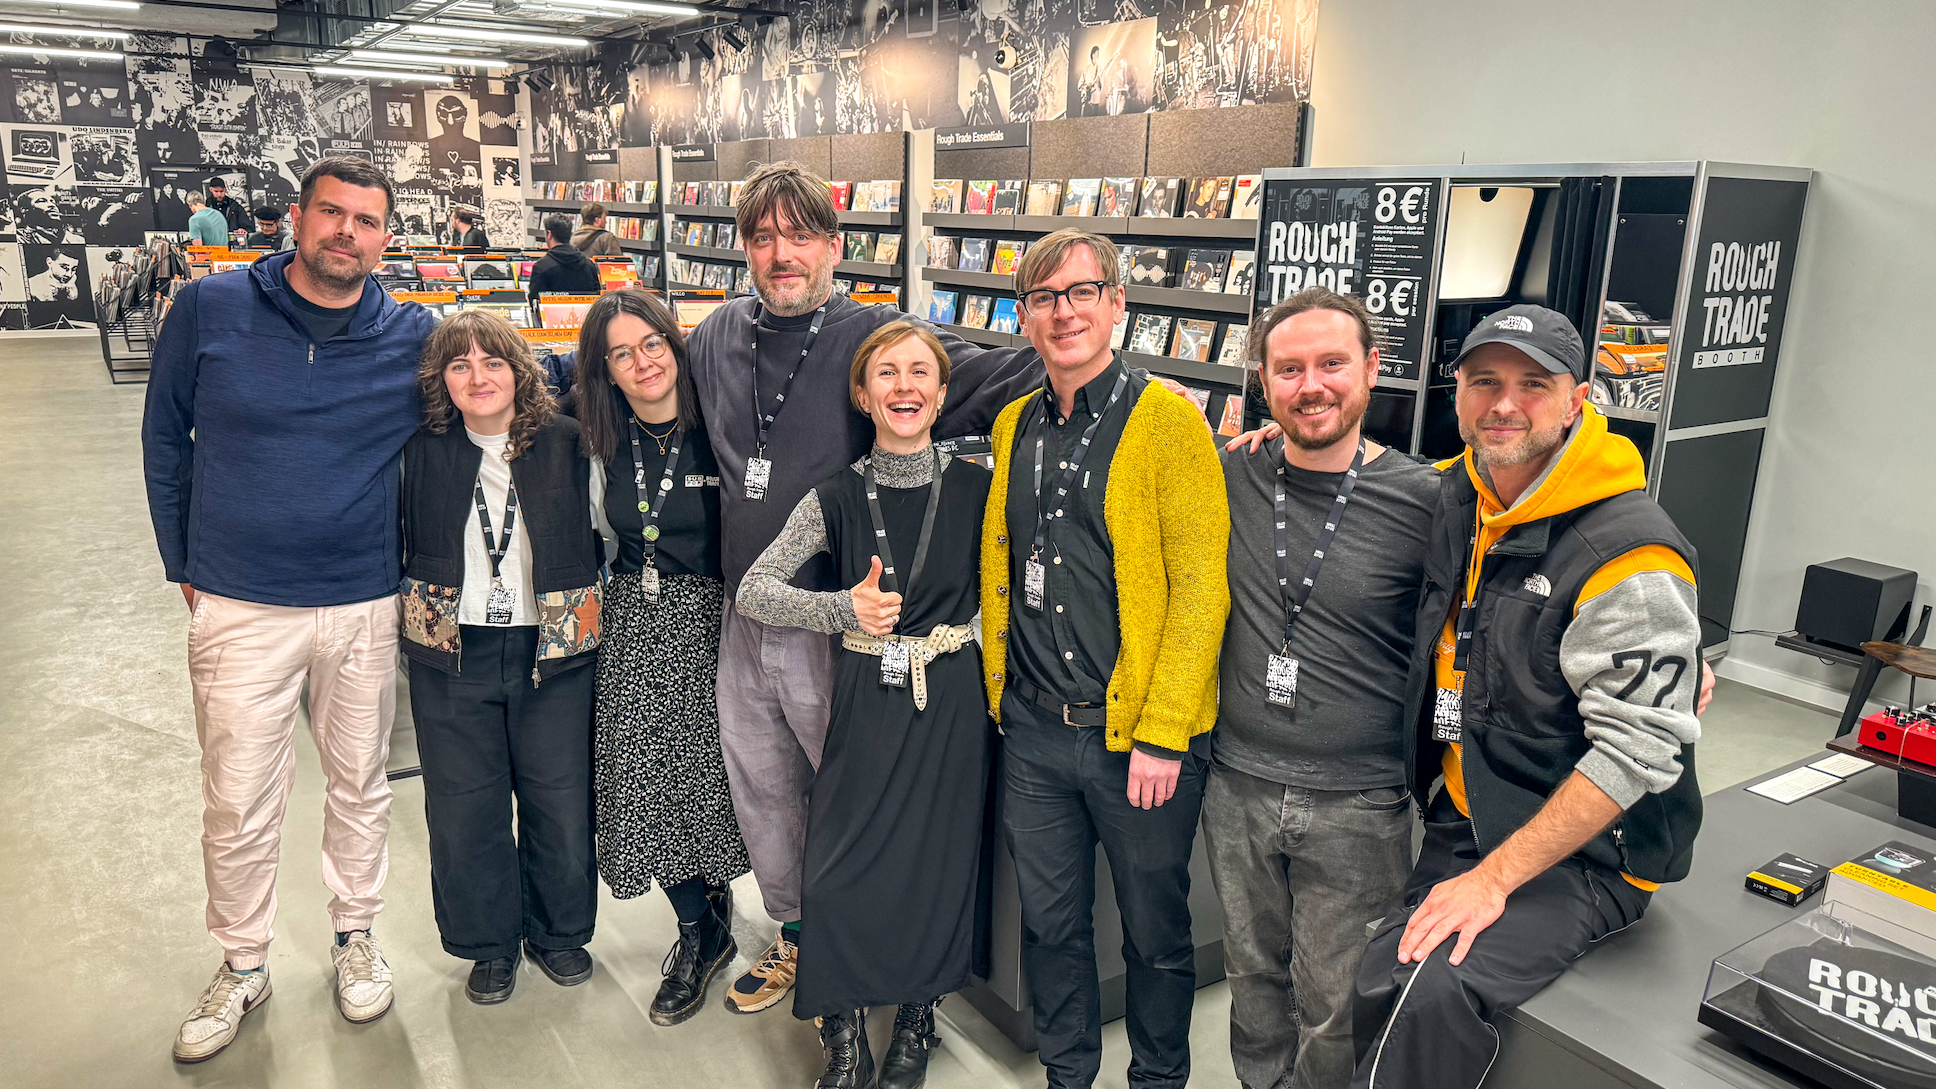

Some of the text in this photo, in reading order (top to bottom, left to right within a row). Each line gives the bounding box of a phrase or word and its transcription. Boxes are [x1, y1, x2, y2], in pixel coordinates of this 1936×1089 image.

[937, 130, 1004, 146] Rough Trade Essentials
[1268, 221, 1357, 265] ROUGH
[1705, 240, 1781, 293] ROUGH
[1412, 281, 1420, 306] session
[1702, 295, 1773, 348] TRADE
[1697, 350, 1761, 365] BOOTH
[883, 675, 904, 685] Staff
[1268, 692, 1291, 705] Staff
[1437, 729, 1461, 741] Staf
[1808, 957, 1936, 1017] ROUG
[1808, 983, 1936, 1046] TRAD
